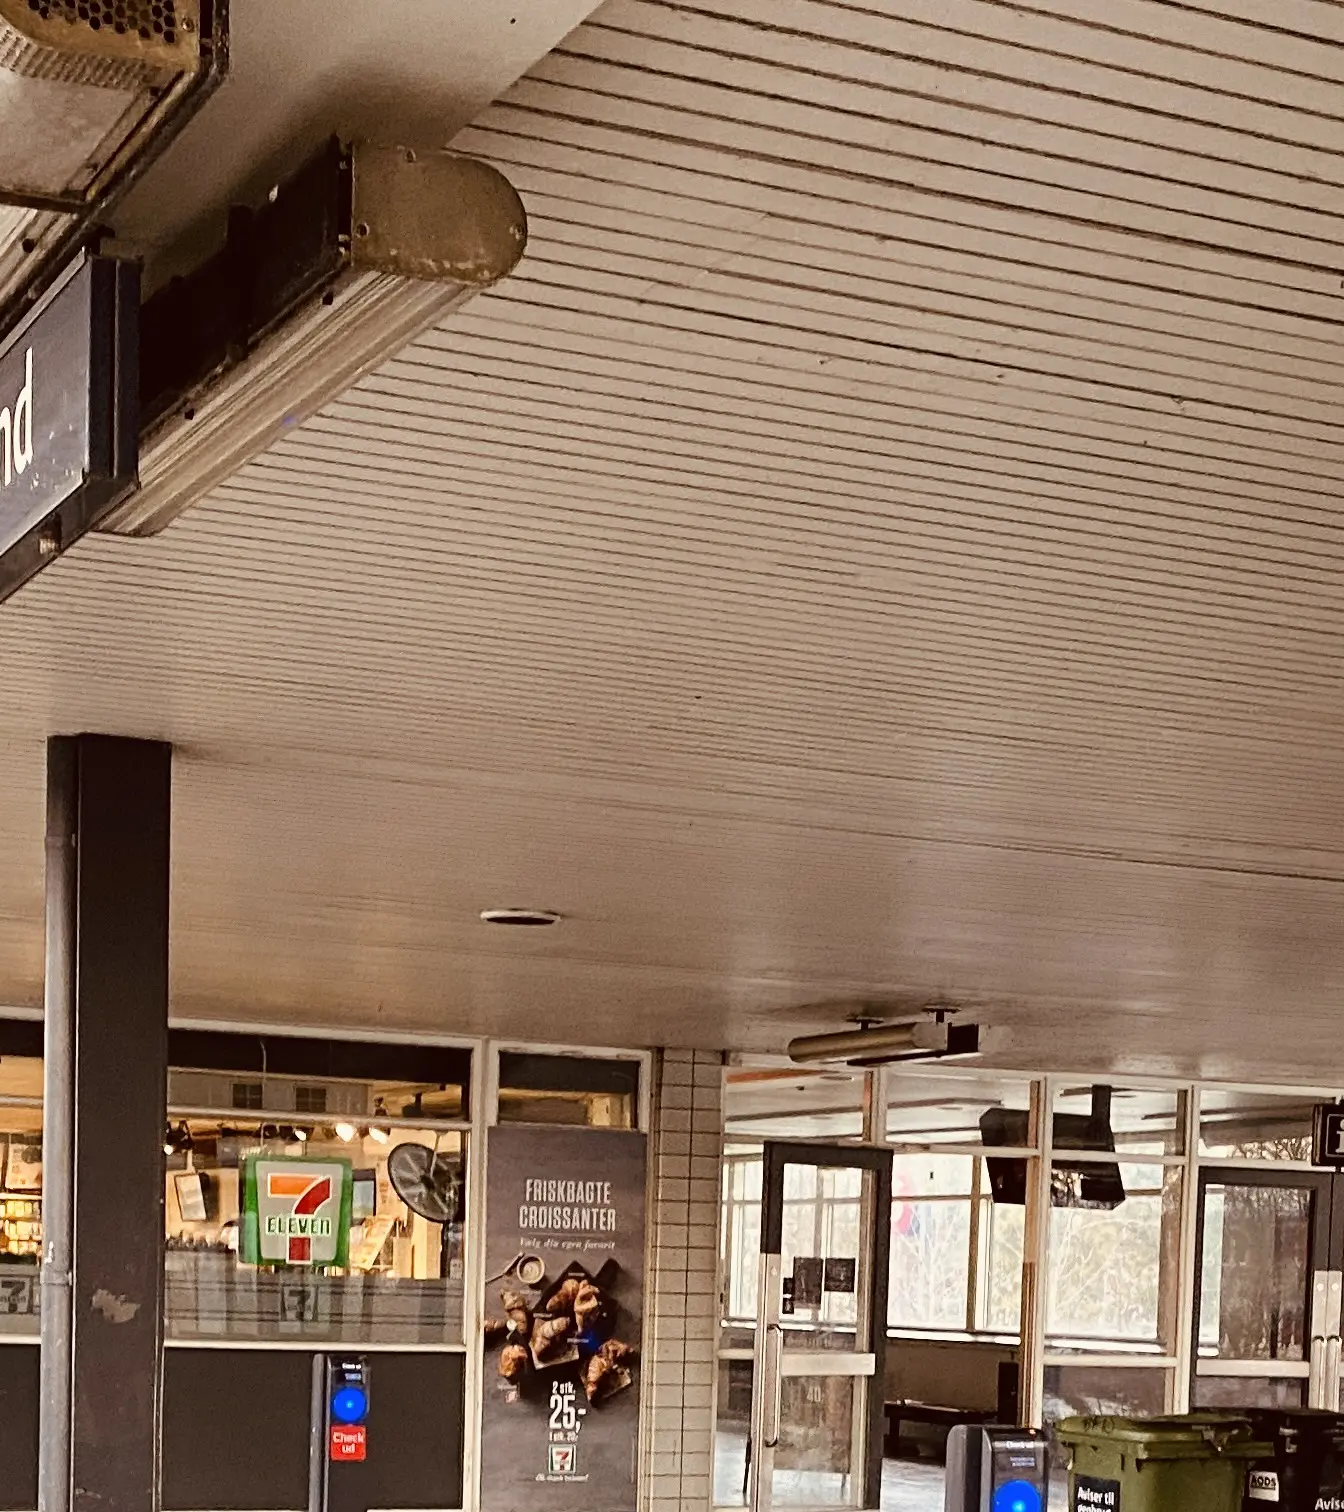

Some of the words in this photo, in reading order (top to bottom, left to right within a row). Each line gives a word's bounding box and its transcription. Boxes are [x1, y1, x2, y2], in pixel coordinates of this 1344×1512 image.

[524, 1178, 612, 1205] FRISKBAGTE
[518, 1205, 616, 1232] CROISSANTER
[552, 1380, 559, 1394] 2
[333, 1432, 365, 1443] Check
[342, 1443, 356, 1454] ud
[1077, 1486, 1103, 1504] Aviser
[1104, 1491, 1115, 1506] til
